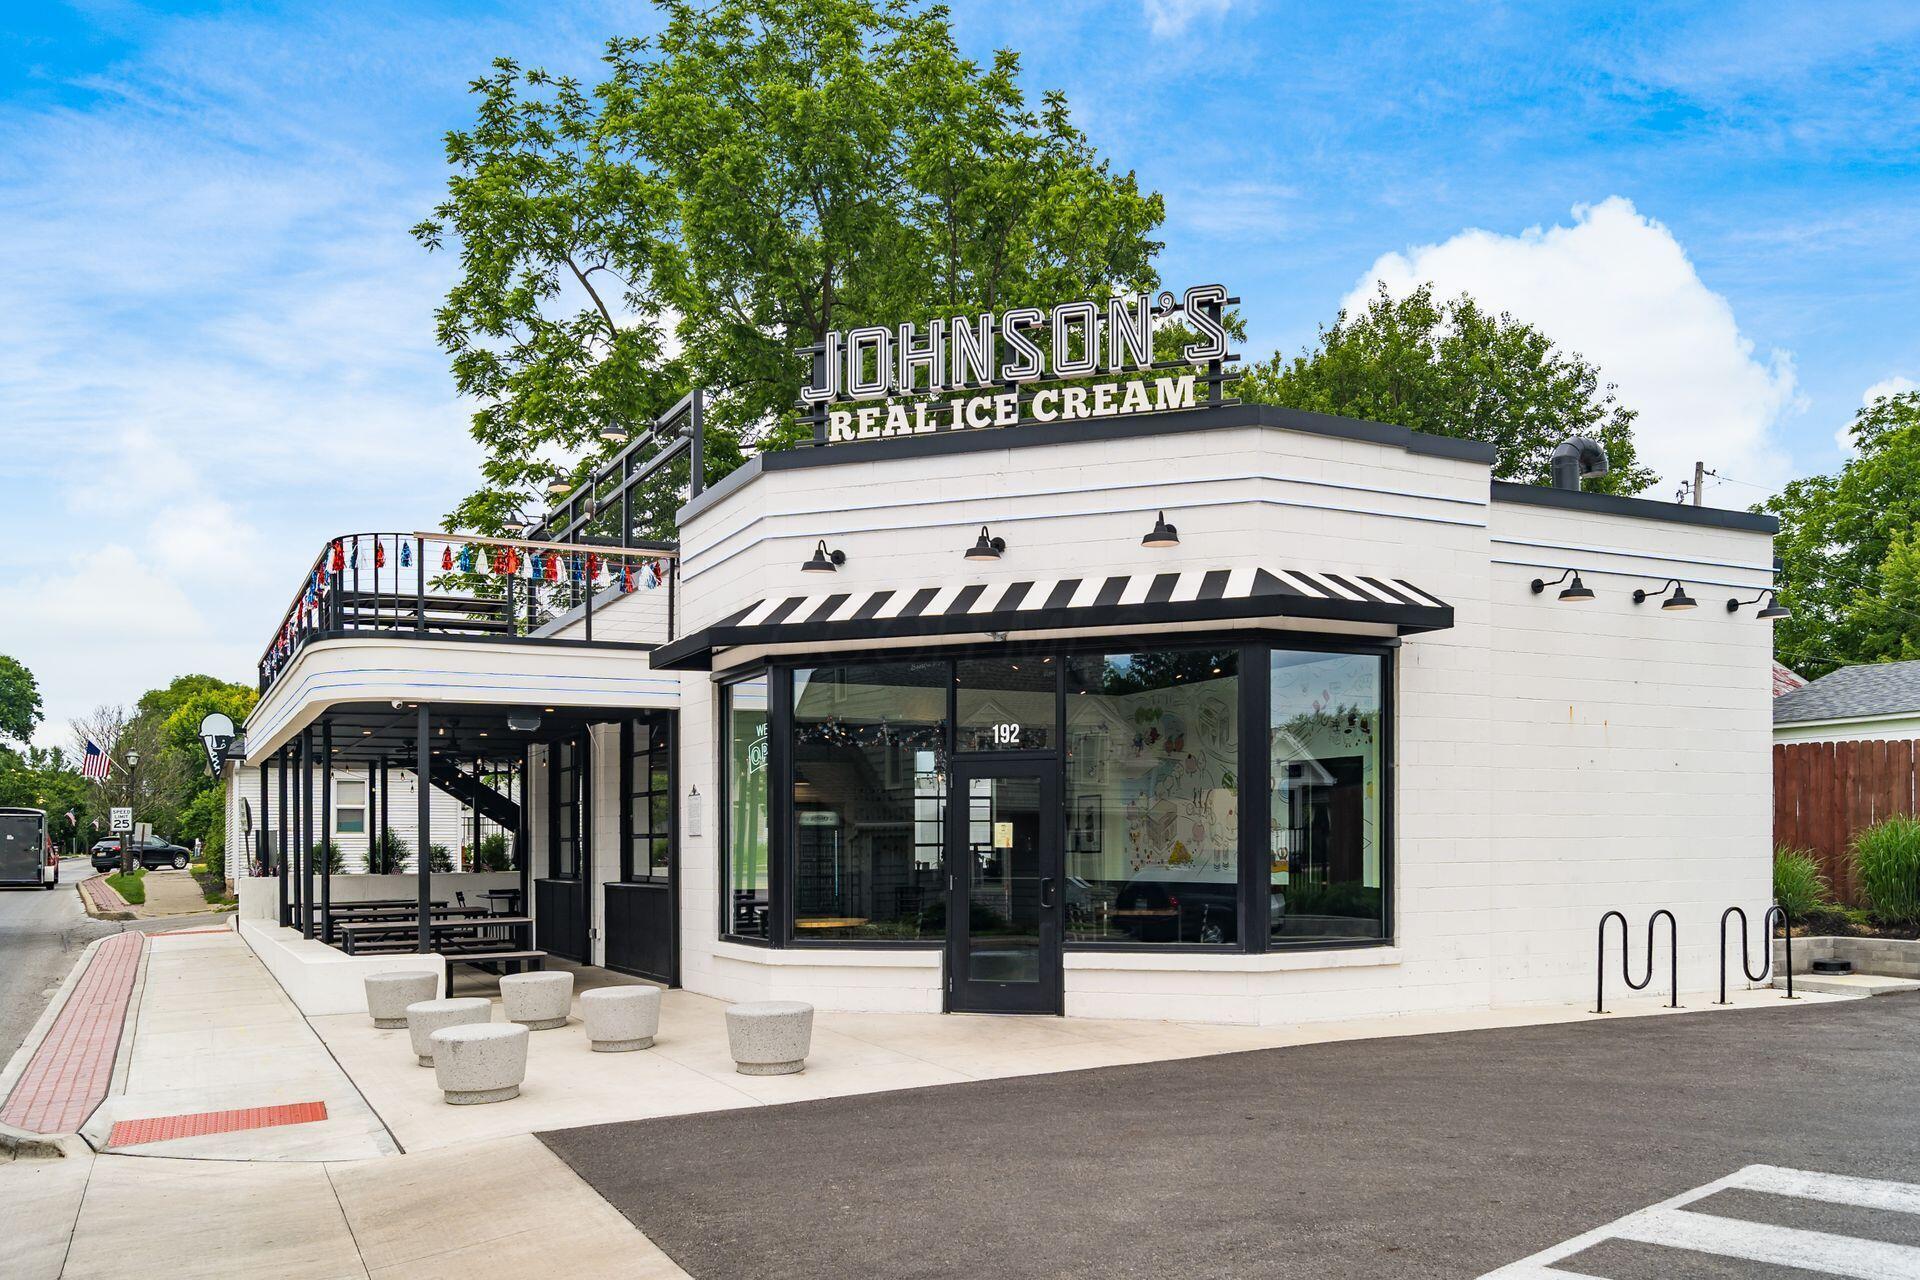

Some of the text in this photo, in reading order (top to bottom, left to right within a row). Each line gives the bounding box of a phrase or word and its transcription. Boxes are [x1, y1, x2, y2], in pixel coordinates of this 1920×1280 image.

[800, 284, 1228, 401] JOHNSON'S
[829, 375, 1197, 442] REAL ICE CREAM
[992, 723, 1020, 744] 192
[113, 819, 130, 829] 25
